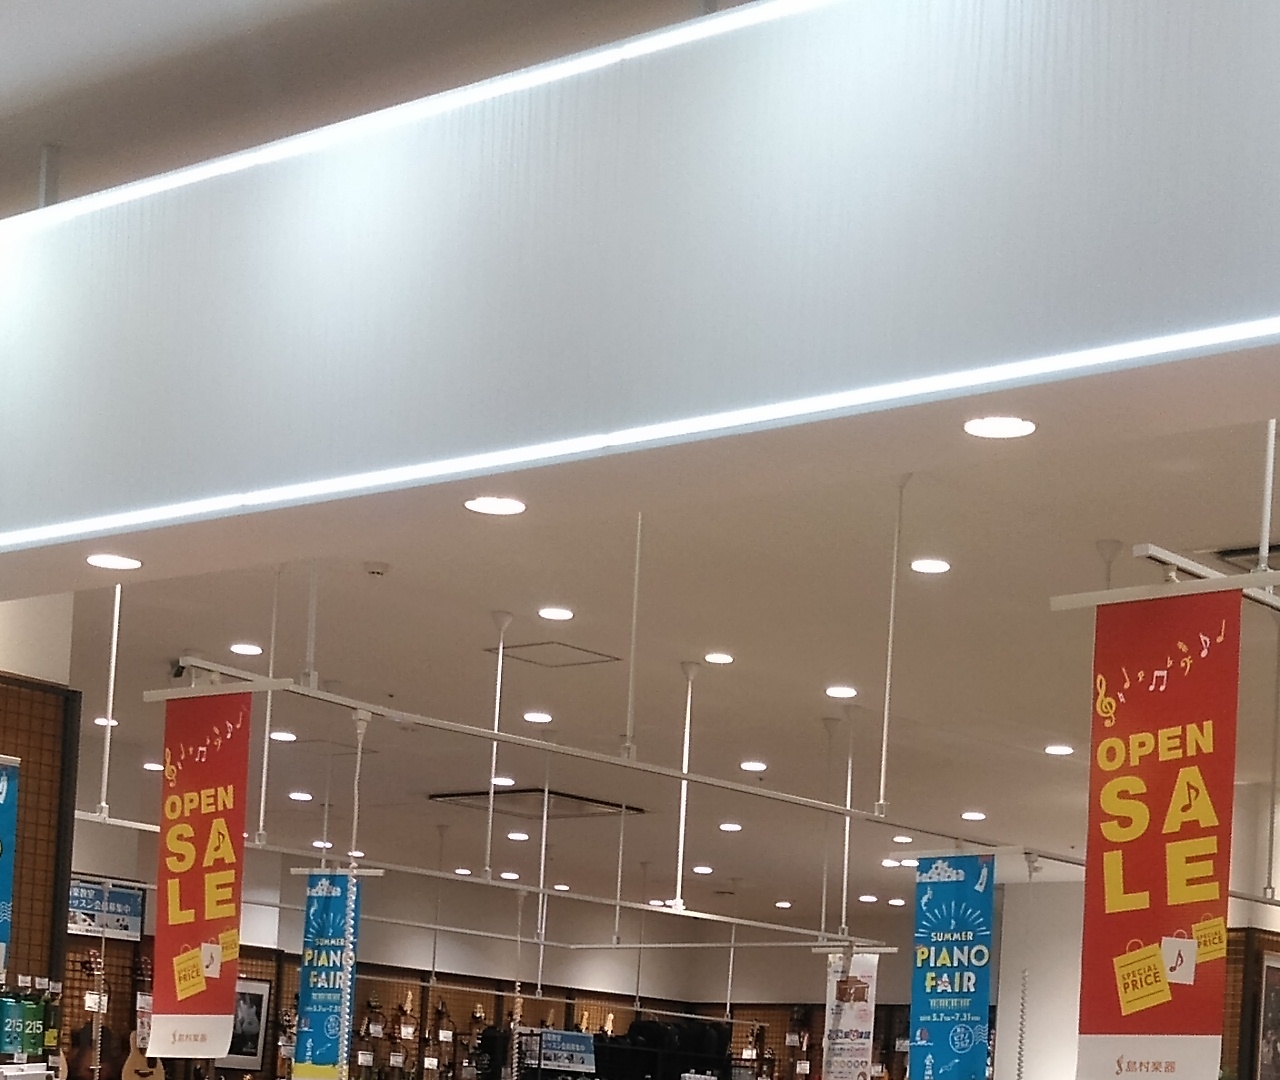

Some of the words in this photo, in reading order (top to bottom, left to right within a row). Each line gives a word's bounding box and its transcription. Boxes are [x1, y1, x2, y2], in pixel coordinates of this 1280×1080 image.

[1097, 720, 1214, 771] OPEN
[164, 784, 234, 820] OPEN
[931, 932, 974, 942] SUMMER
[1198, 936, 1224, 948] PRICE
[916, 944, 990, 968] PIANO
[178, 969, 201, 984] PRICE
[1121, 964, 1158, 981] SPECIAL
[925, 971, 976, 994] FAIR
[1123, 971, 1162, 994] PRICE
[5, 1019, 23, 1032] 215
[25, 1021, 43, 1034] 215
[1125, 1061, 1176, 1073] 島村楽器
